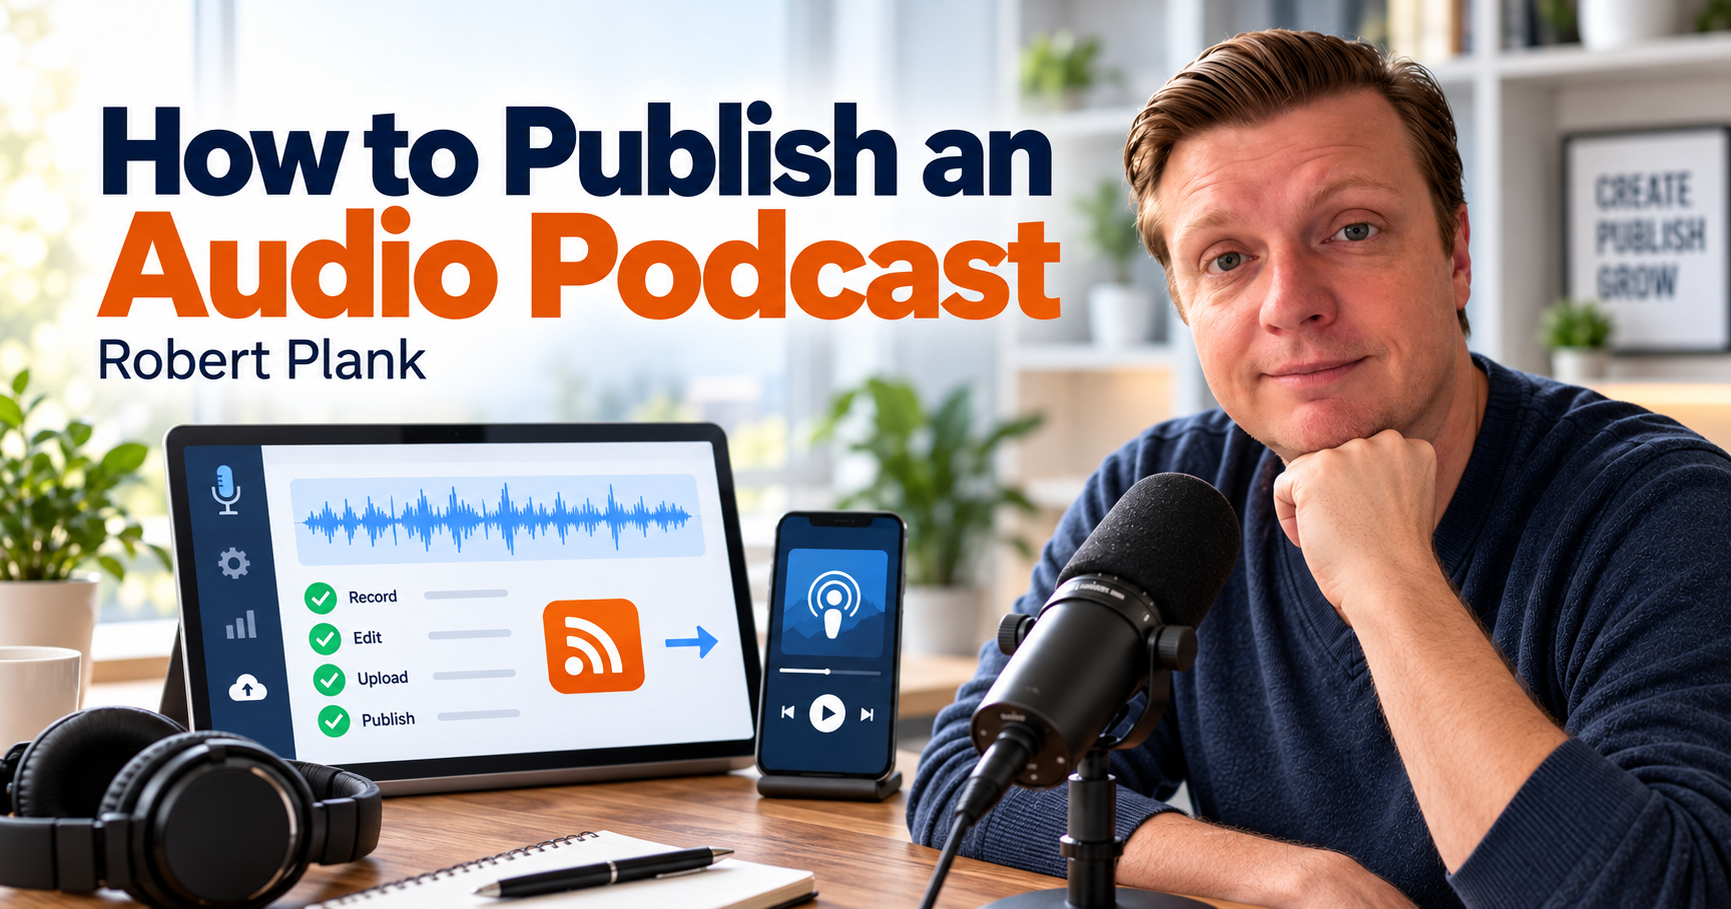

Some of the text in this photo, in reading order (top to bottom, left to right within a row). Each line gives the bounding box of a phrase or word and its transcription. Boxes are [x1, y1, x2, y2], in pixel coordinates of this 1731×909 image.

[1595, 172, 1692, 210] CREATE
[1596, 215, 1707, 255] PUBLISH
[1597, 262, 1679, 301] GROW
[348, 589, 398, 604] Record
[353, 630, 383, 645] Edit
[357, 670, 409, 689] Upload
[361, 711, 416, 728] Publish
